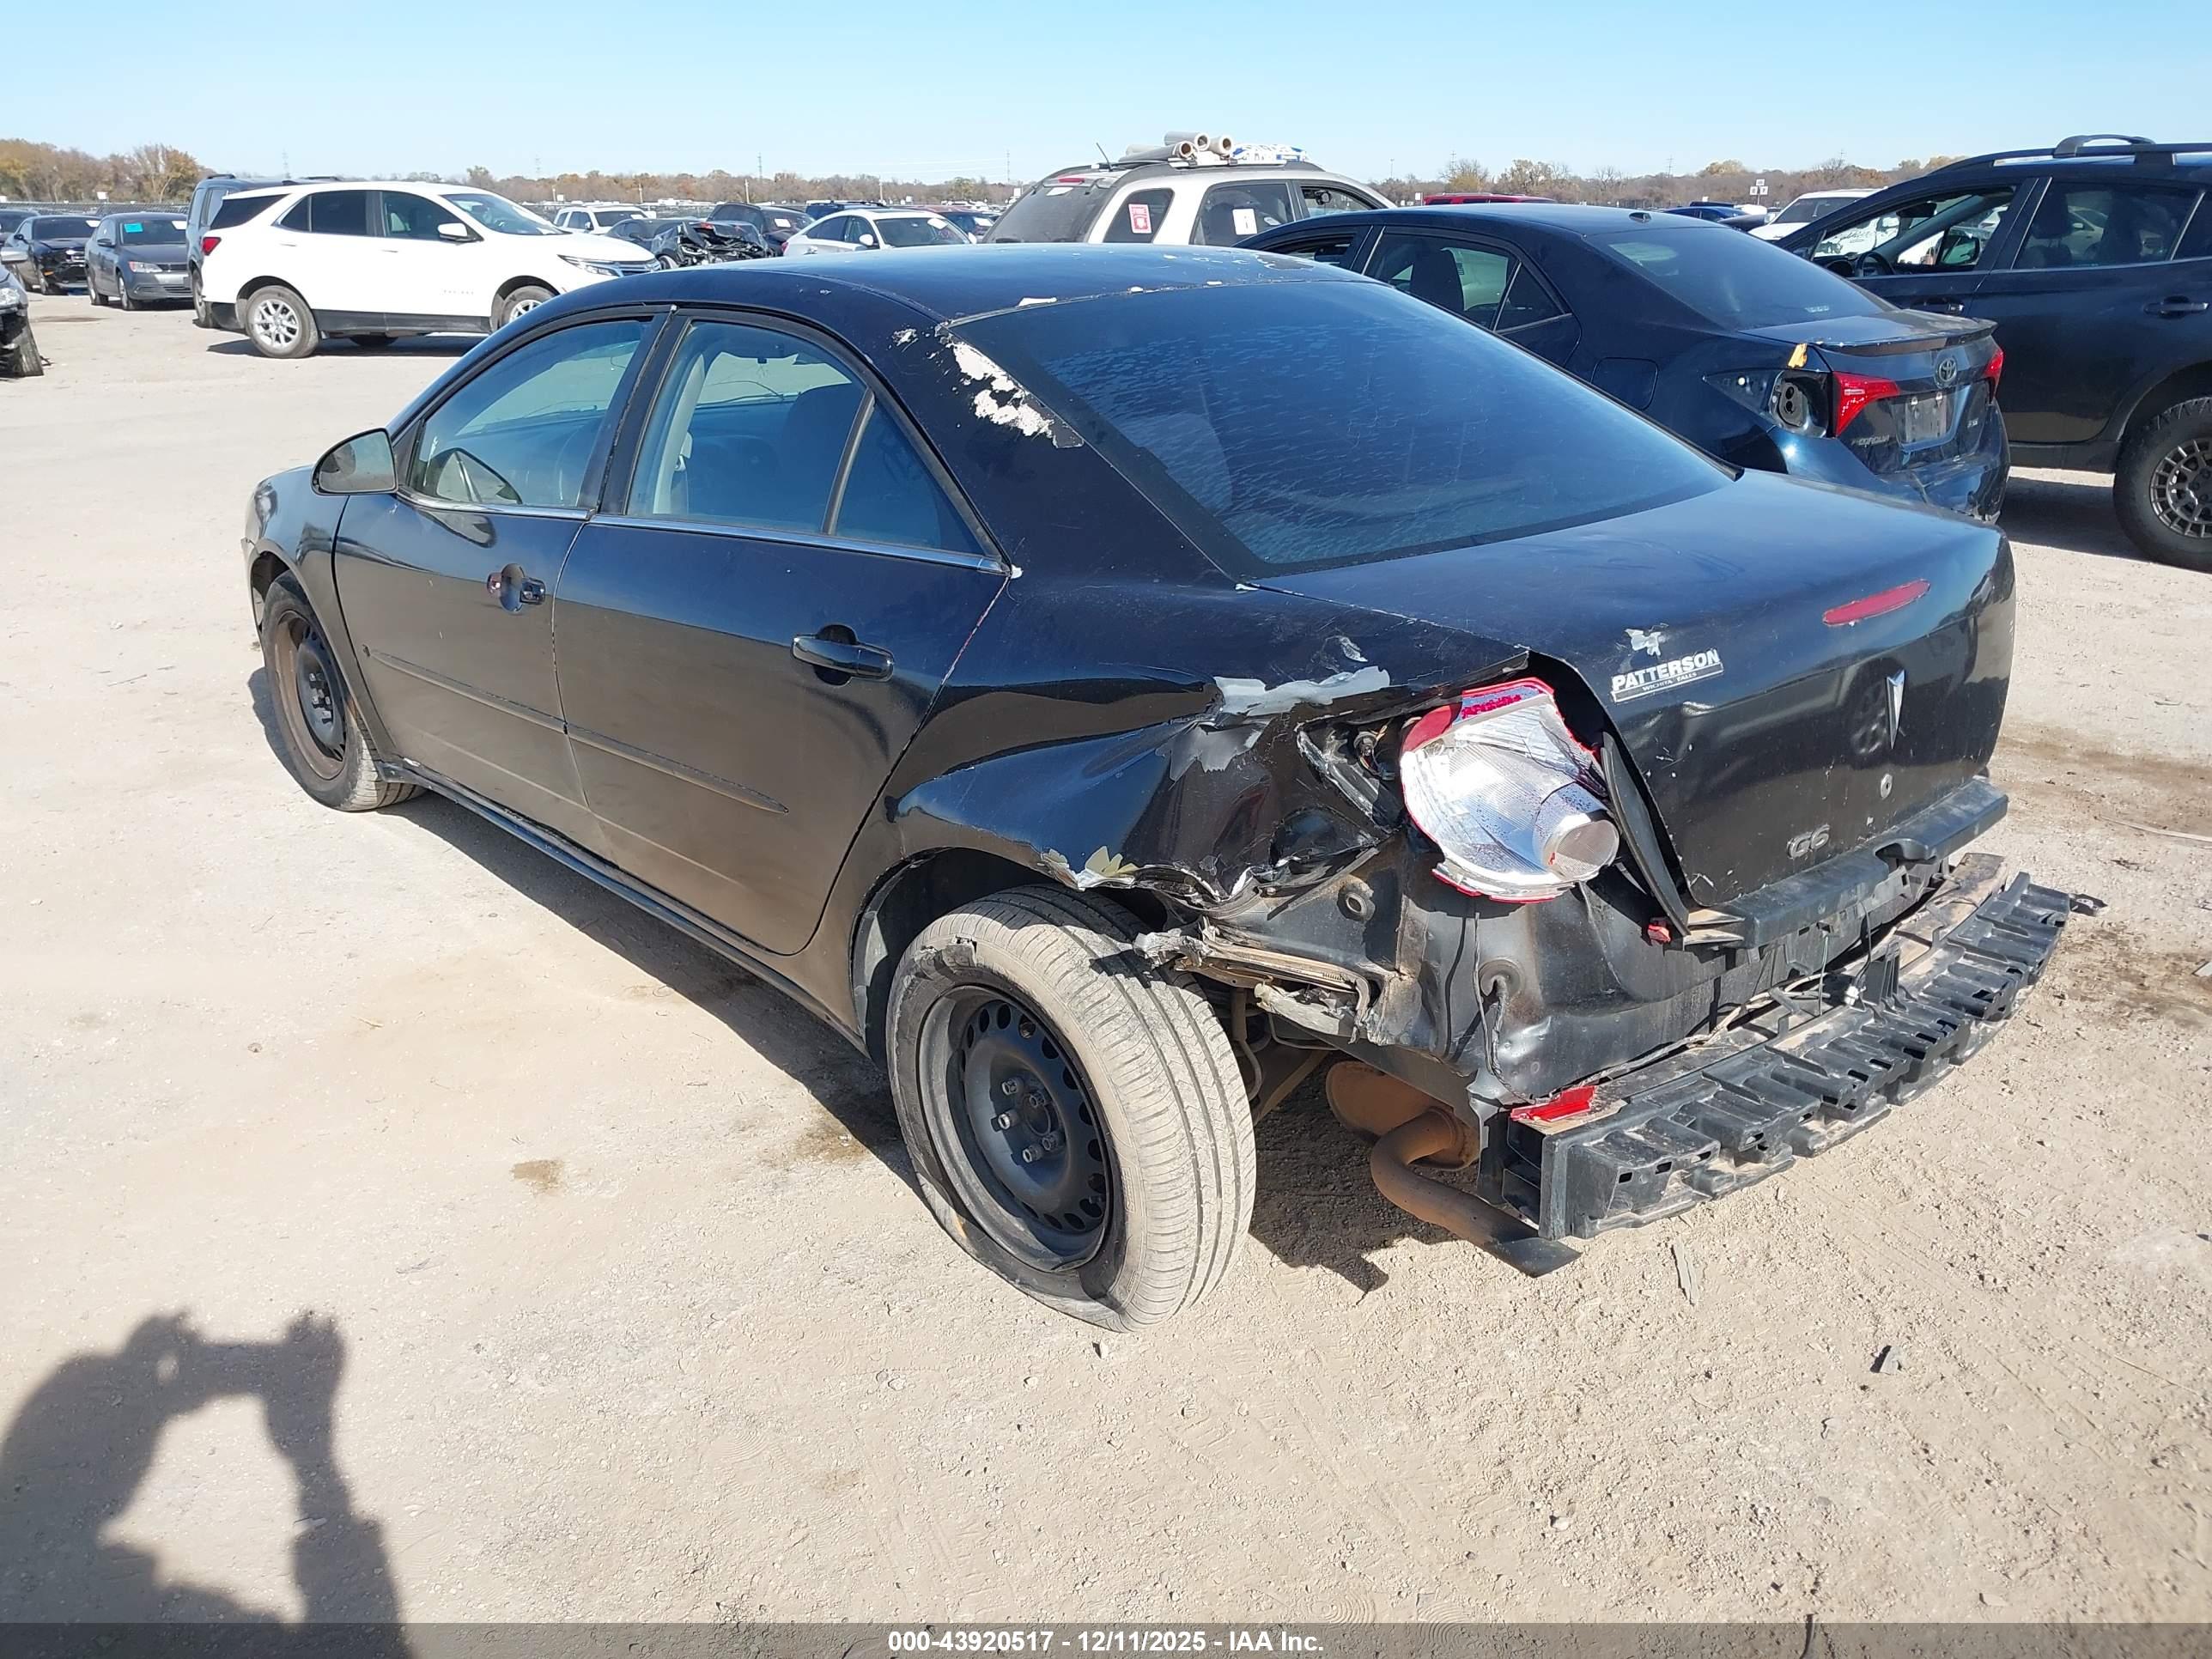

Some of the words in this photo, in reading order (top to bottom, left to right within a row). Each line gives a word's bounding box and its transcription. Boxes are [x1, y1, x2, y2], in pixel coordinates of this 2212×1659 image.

[1612, 648, 1720, 691] PATTERSON
[1642, 679, 1674, 691] WICHITA
[1676, 672, 1697, 682] FALLS
[1787, 824, 1830, 859] G6
